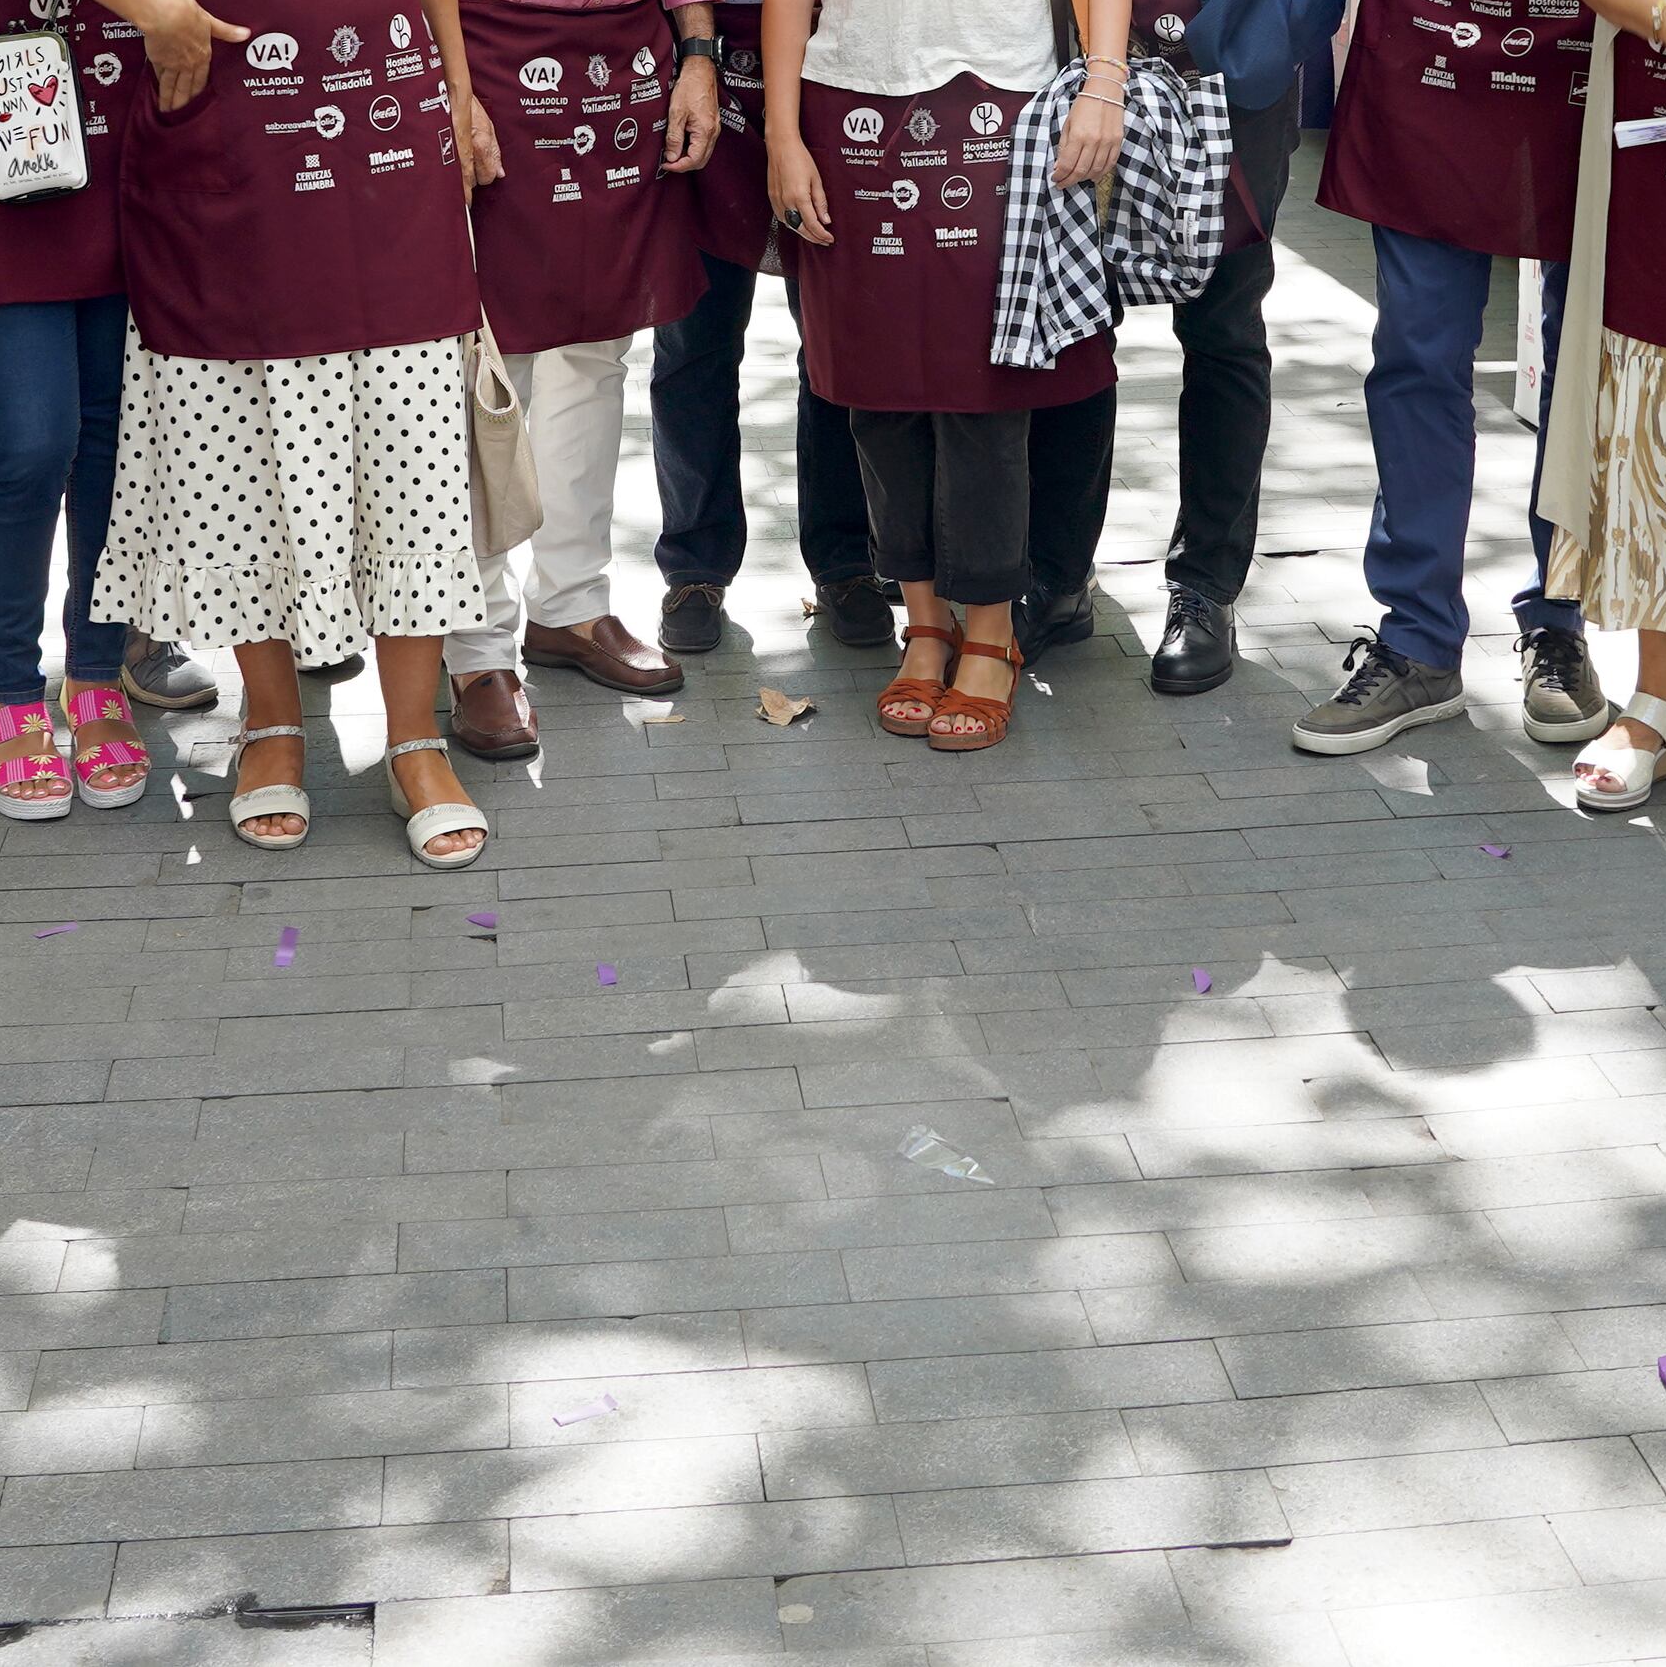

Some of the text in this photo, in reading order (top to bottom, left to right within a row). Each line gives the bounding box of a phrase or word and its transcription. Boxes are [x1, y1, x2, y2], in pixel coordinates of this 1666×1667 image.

[1470, 2, 1512, 18] Valladolid
[251, 43, 290, 63] VA!
[385, 54, 421, 69] Hostelería
[397, 63, 424, 74] Valladolid
[322, 70, 362, 82] Ayuntamiento
[524, 67, 556, 83] VA!
[1424, 67, 1455, 81] CERVEZAS
[1491, 70, 1536, 85] Mahou
[243, 76, 304, 88] VALLADOLID
[321, 75, 373, 93] Valladolid
[1421, 74, 1456, 90] ALHAMBRA
[582, 100, 621, 114] Valladolid
[848, 117, 877, 135] VA!
[28, 121, 71, 150] FUN
[369, 148, 414, 165] Mahou
[901, 155, 947, 168] Valladolid
[296, 169, 332, 182] CERVEZAS
[606, 166, 640, 181] Mahou
[295, 179, 335, 192] ALHAMBRA
[935, 226, 978, 241] Mahou
[873, 237, 903, 247] CERVEZAS
[872, 246, 904, 256] ALHAMBRA
